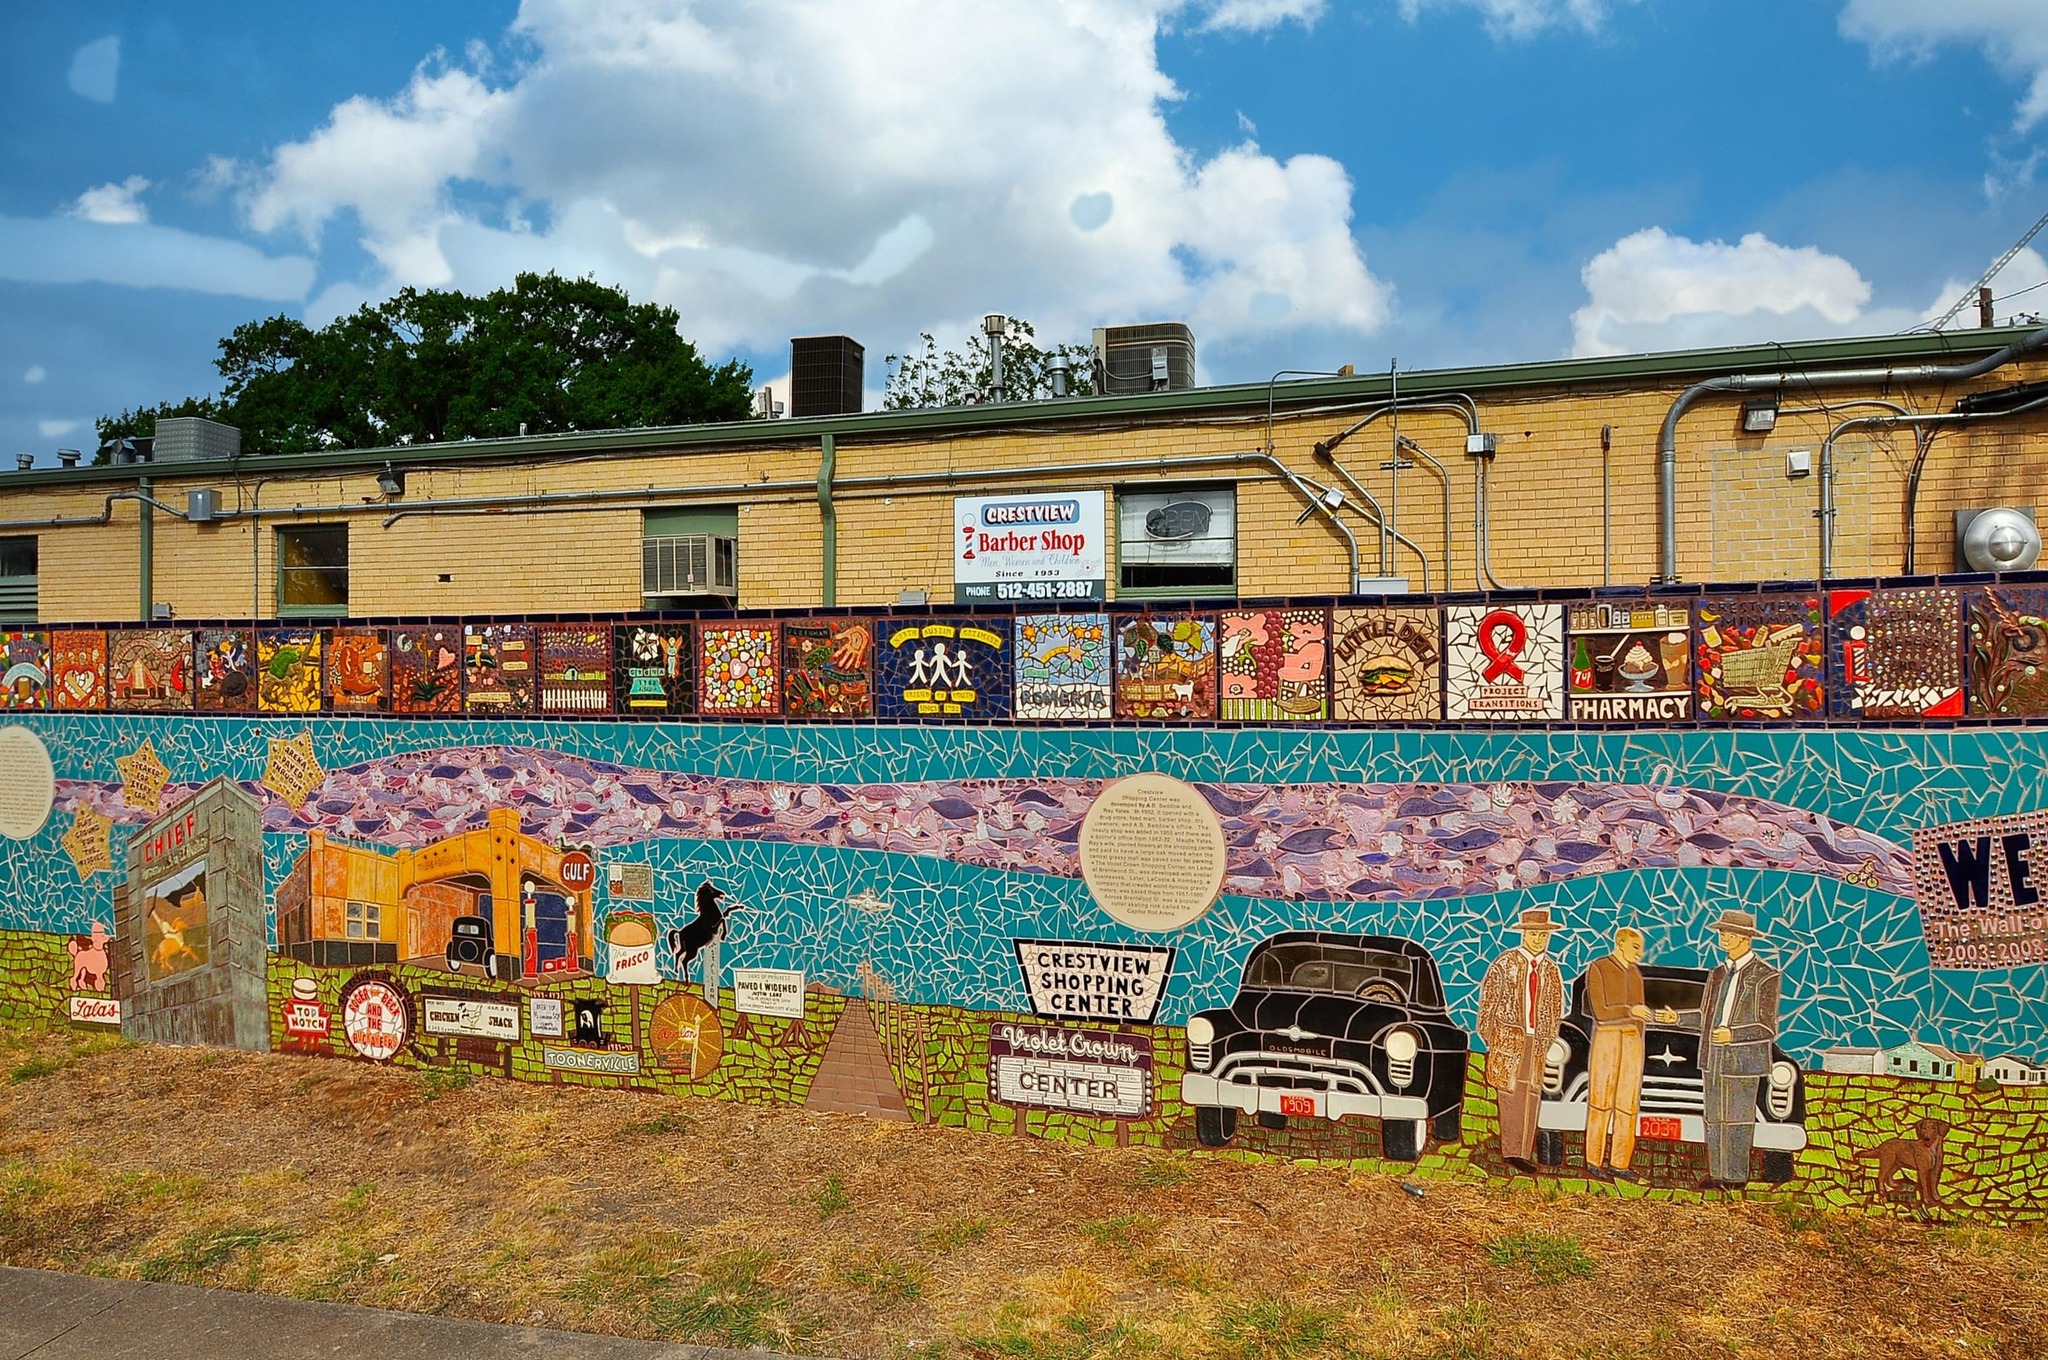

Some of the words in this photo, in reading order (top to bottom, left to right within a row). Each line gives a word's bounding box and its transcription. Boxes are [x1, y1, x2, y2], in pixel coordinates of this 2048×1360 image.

[986, 502, 1075, 525] CRESTVIEW
[978, 531, 1037, 552] Barber
[1041, 529, 1085, 556] Shop
[1003, 555, 1030, 567] Women
[1032, 556, 1045, 566] and
[1049, 554, 1080, 565] Children
[965, 586, 991, 597] PHONE
[997, 582, 1093, 599] 512-451-2887
[1707, 600, 1801, 613] CRESTVIEW
[924, 628, 952, 636] AUSTIN
[961, 630, 999, 645] OPTIMIST
[1337, 619, 1395, 660] LITTLE
[1398, 622, 1441, 667] DELI
[905, 690, 930, 698] FRIEND
[1021, 689, 1107, 708] ROMERIA
[1473, 699, 1539, 708] TRANSITIONS
[1571, 697, 1689, 720] PHARMACY
[284, 746, 307, 769] ARENA
[267, 760, 303, 793] THRUOUT
[144, 812, 195, 863] CHIEF
[562, 863, 590, 881] GULF
[1934, 921, 1970, 937] The
[1978, 916, 2022, 935] Wall
[612, 948, 627, 959] The
[1945, 945, 1989, 962] 2003
[1998, 939, 2043, 960] 2008
[615, 950, 649, 971] FRISCO
[1037, 952, 1151, 976] CRESTVIEW
[738, 981, 758, 991] PAVED
[764, 983, 798, 994] WIDENED
[1041, 972, 1144, 997] SHOPPING
[73, 1000, 119, 1019] Lala's
[296, 1007, 317, 1017] TOP
[348, 988, 370, 1013] ROGER
[381, 992, 400, 1017] BECK
[367, 1004, 382, 1016] AND
[1051, 993, 1132, 1017] CENTER
[291, 1017, 325, 1029] NOTCH
[368, 1017, 382, 1031] THE
[429, 1011, 460, 1023] CHICKEN
[488, 1016, 513, 1028] SHACK
[1003, 1026, 1067, 1053] Violet
[1070, 1033, 1139, 1062] Crown
[1269, 1045, 1327, 1056] OLDSMOBILE
[547, 1053, 637, 1072] TOONERVILLE
[1019, 1072, 1117, 1099] CENTER
[1284, 1100, 1311, 1113] 1909
[1642, 1121, 1678, 1136] 2037
